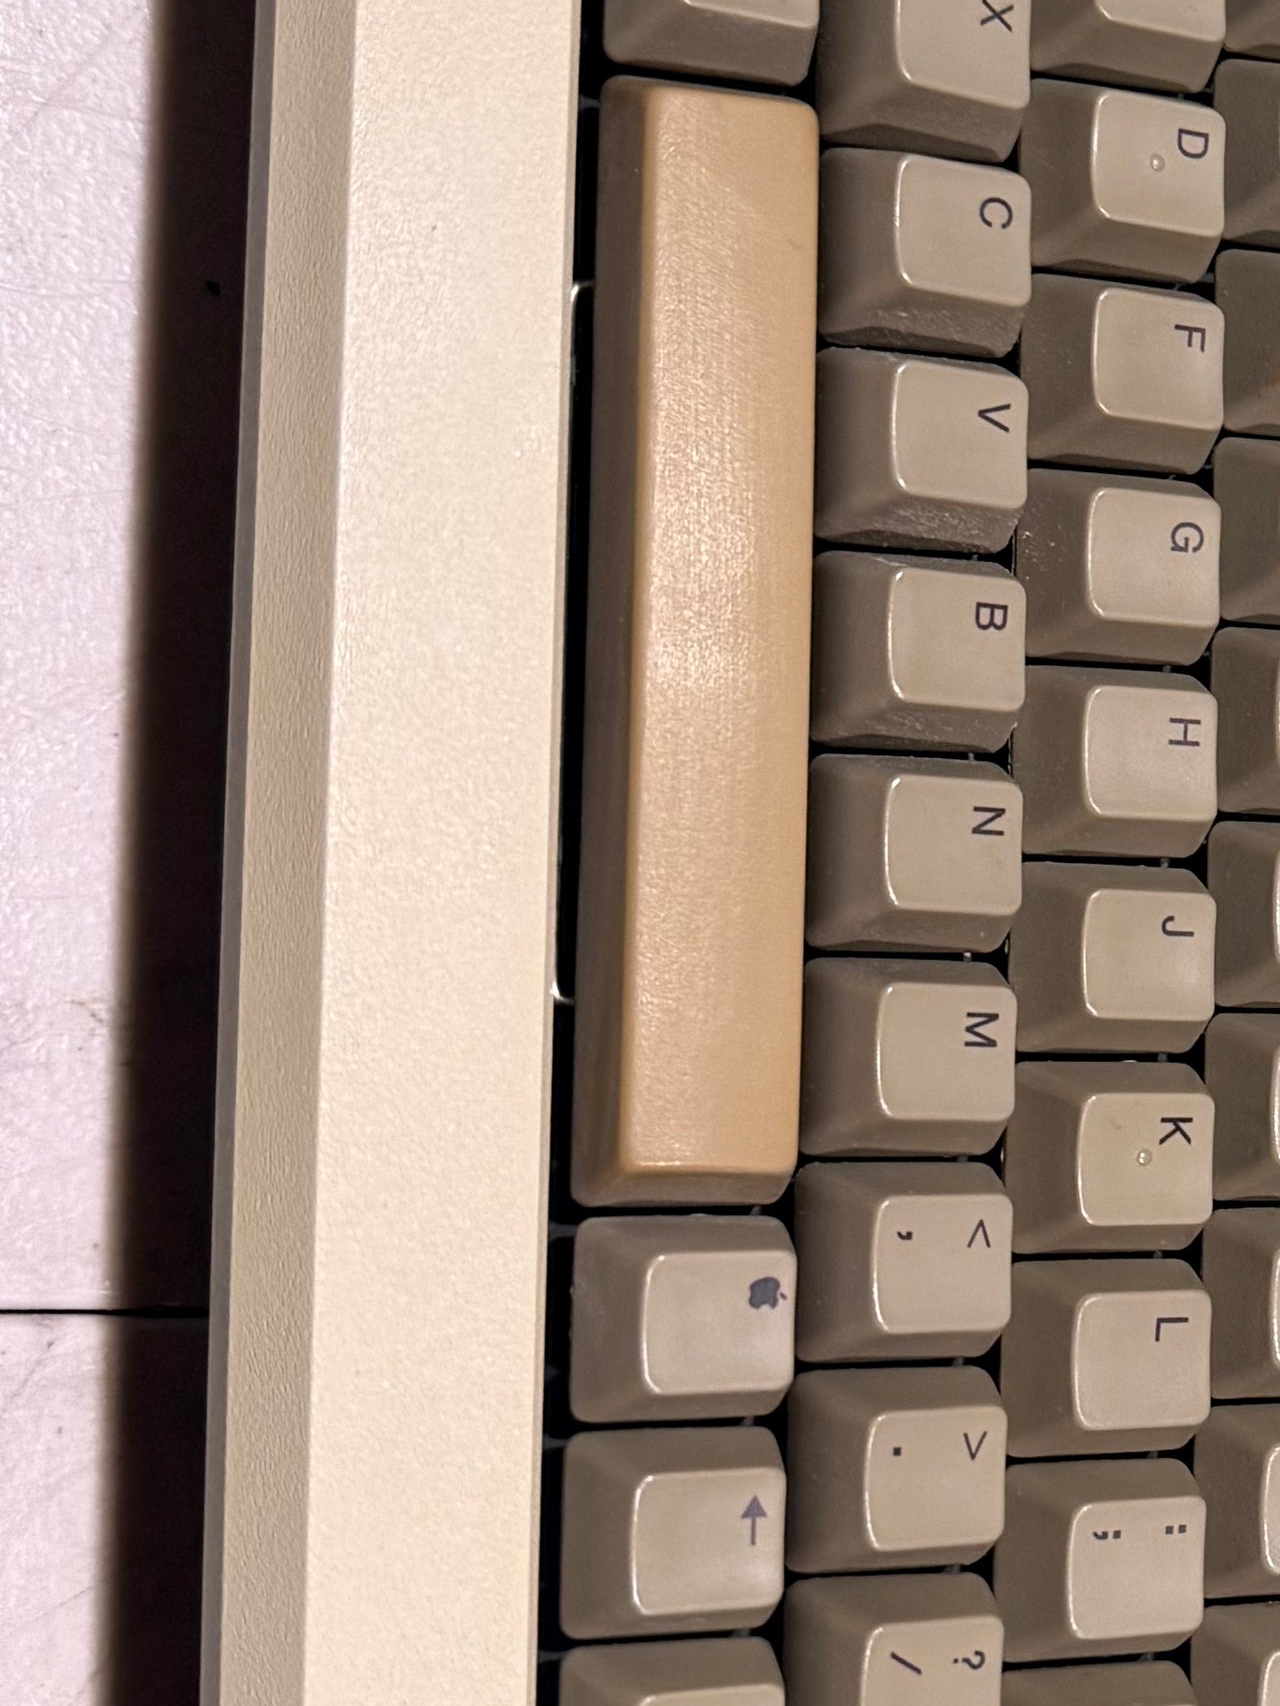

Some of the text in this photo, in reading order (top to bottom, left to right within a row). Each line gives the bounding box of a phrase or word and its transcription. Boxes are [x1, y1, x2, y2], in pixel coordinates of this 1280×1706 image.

[1178, 128, 1209, 159] D
[980, 197, 1013, 229] C
[1174, 324, 1206, 352] F
[978, 404, 1011, 433] V
[1171, 522, 1204, 553] G
[975, 602, 1008, 630] B
[1168, 718, 1201, 746] H
[972, 806, 1006, 836] N
[1162, 916, 1194, 937] J
[964, 1012, 999, 1047] M
[1159, 1117, 1193, 1145] K
[967, 1219, 991, 1248] <
[1155, 1317, 1189, 1342] L
[963, 1431, 987, 1460] >
[1093, 1530, 1121, 1540] ;
[891, 1652, 921, 1675] /
[953, 1650, 985, 1670] ?
